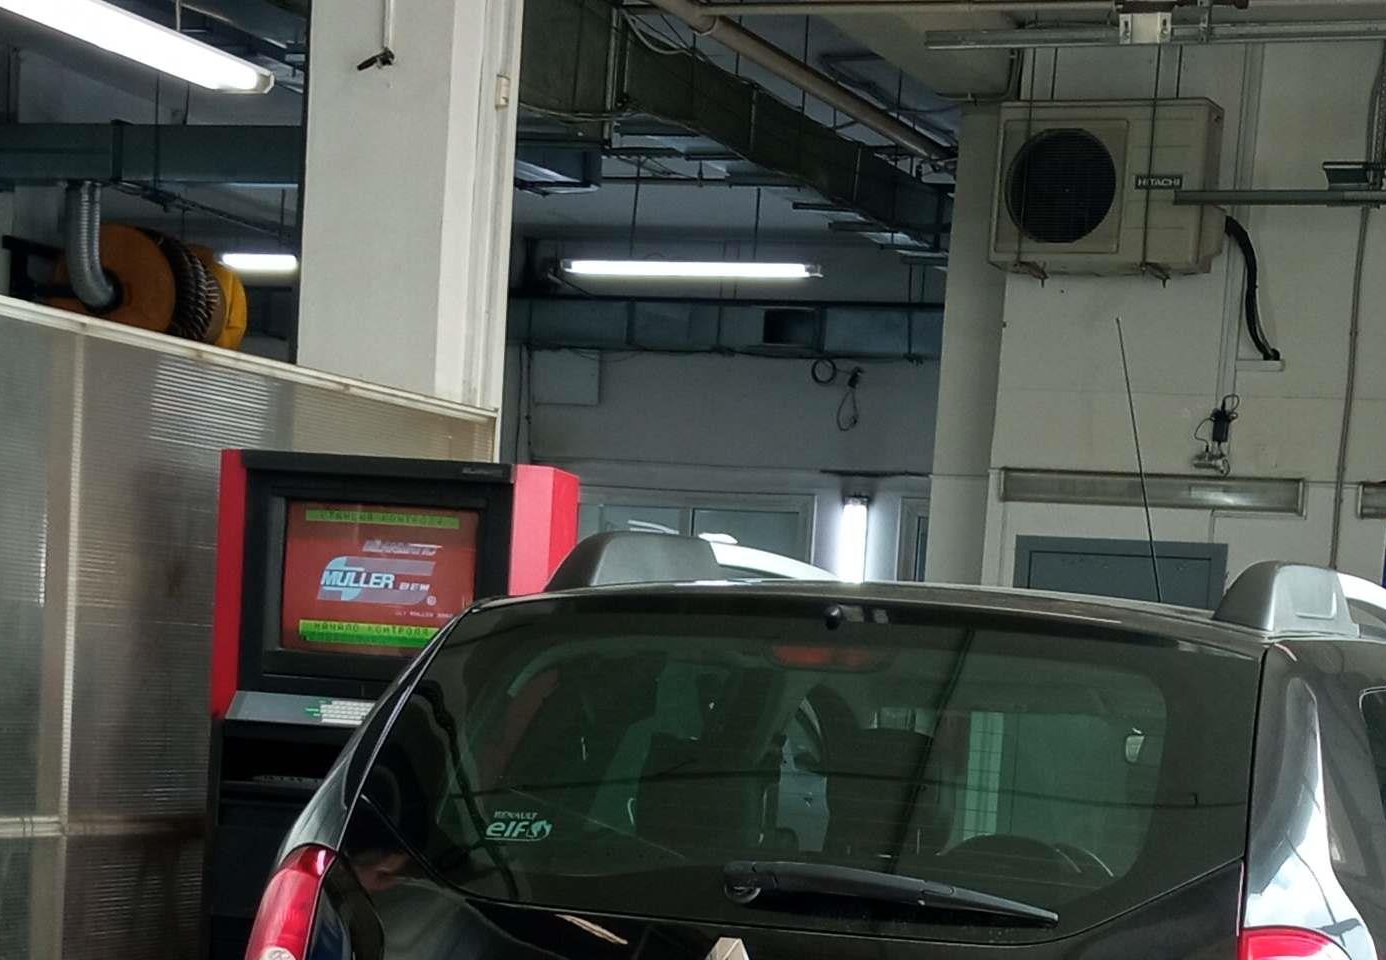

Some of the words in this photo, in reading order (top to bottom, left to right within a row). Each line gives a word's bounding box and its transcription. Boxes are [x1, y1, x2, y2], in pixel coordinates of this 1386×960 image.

[1138, 178, 1181, 186] HITACHI
[321, 570, 394, 589] MULLER
[314, 623, 359, 632] НАЧАЛО
[485, 821, 530, 837] elf
